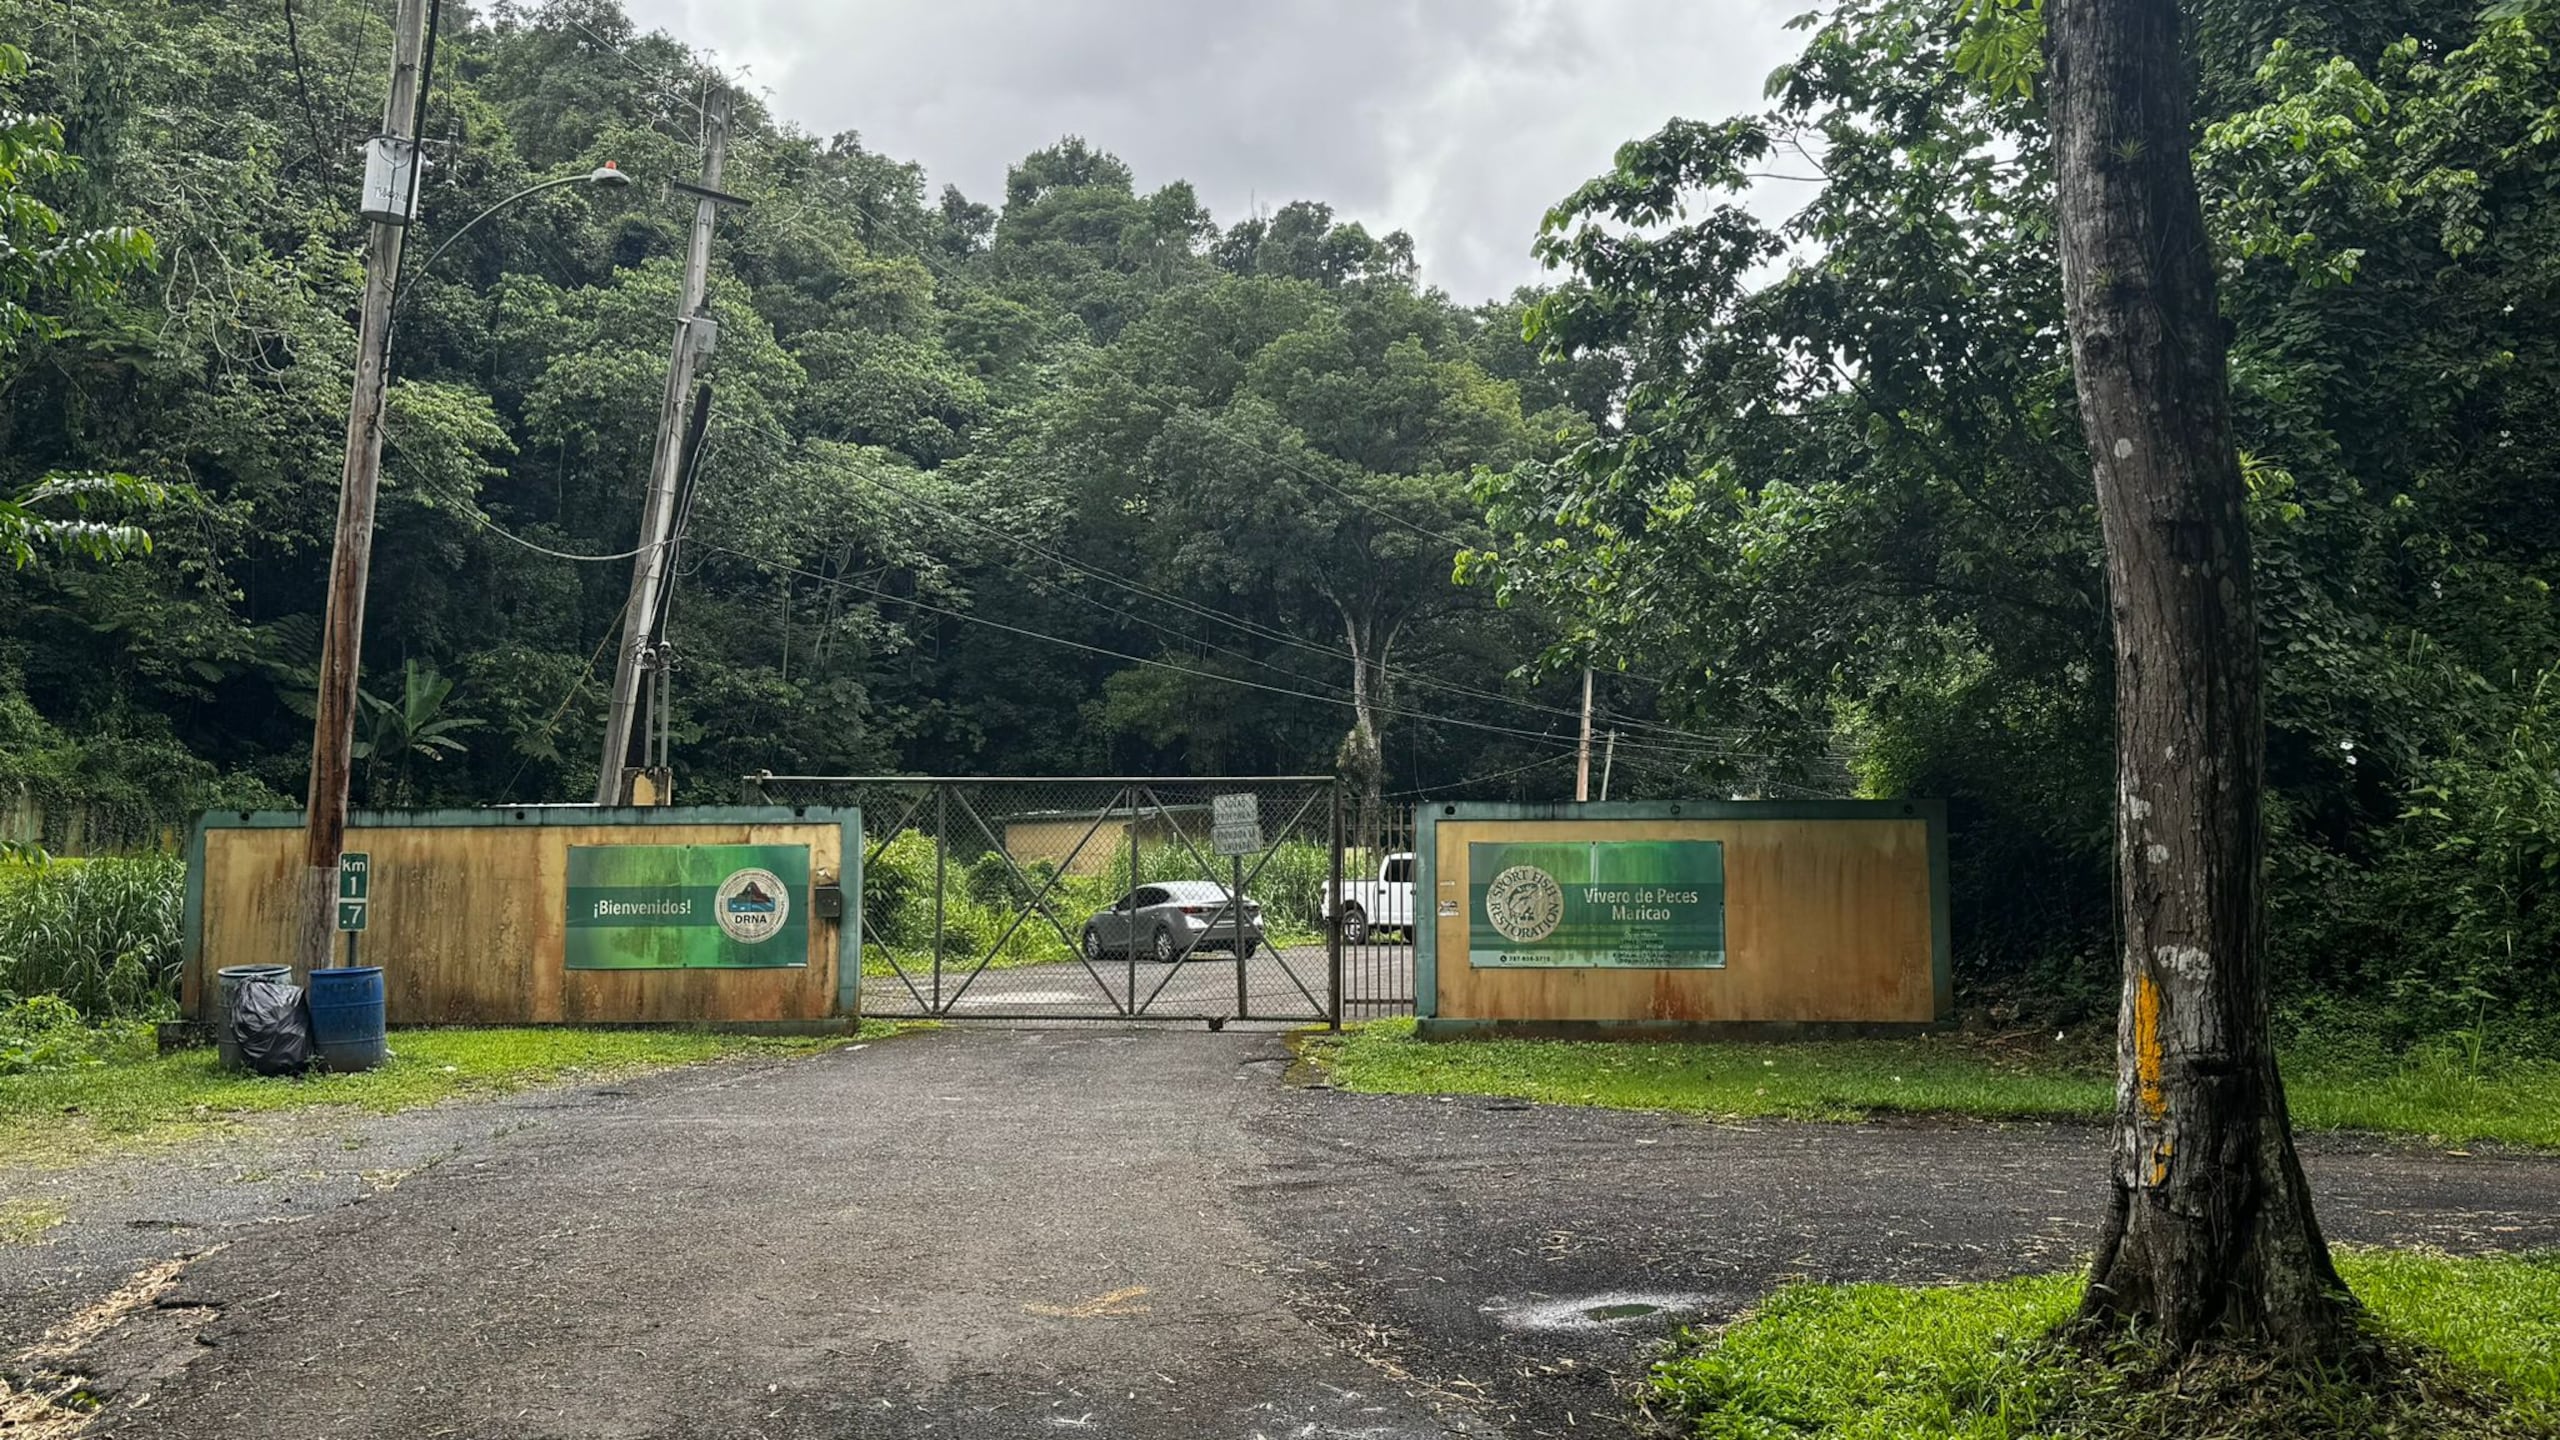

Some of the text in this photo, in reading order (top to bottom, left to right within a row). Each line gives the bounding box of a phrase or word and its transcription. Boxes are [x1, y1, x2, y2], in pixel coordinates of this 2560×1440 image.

[342, 859, 366, 872] km
[350, 876, 357, 896] 1
[1493, 869, 1557, 898] SPORT FISH
[1583, 887, 1698, 904] Vivero de Peces
[593, 899, 692, 919] ¡Bienvenidos!
[1611, 904, 1671, 921] Maricao
[734, 914, 768, 924] DRNA
[1490, 902, 1559, 938] RESTORATION
